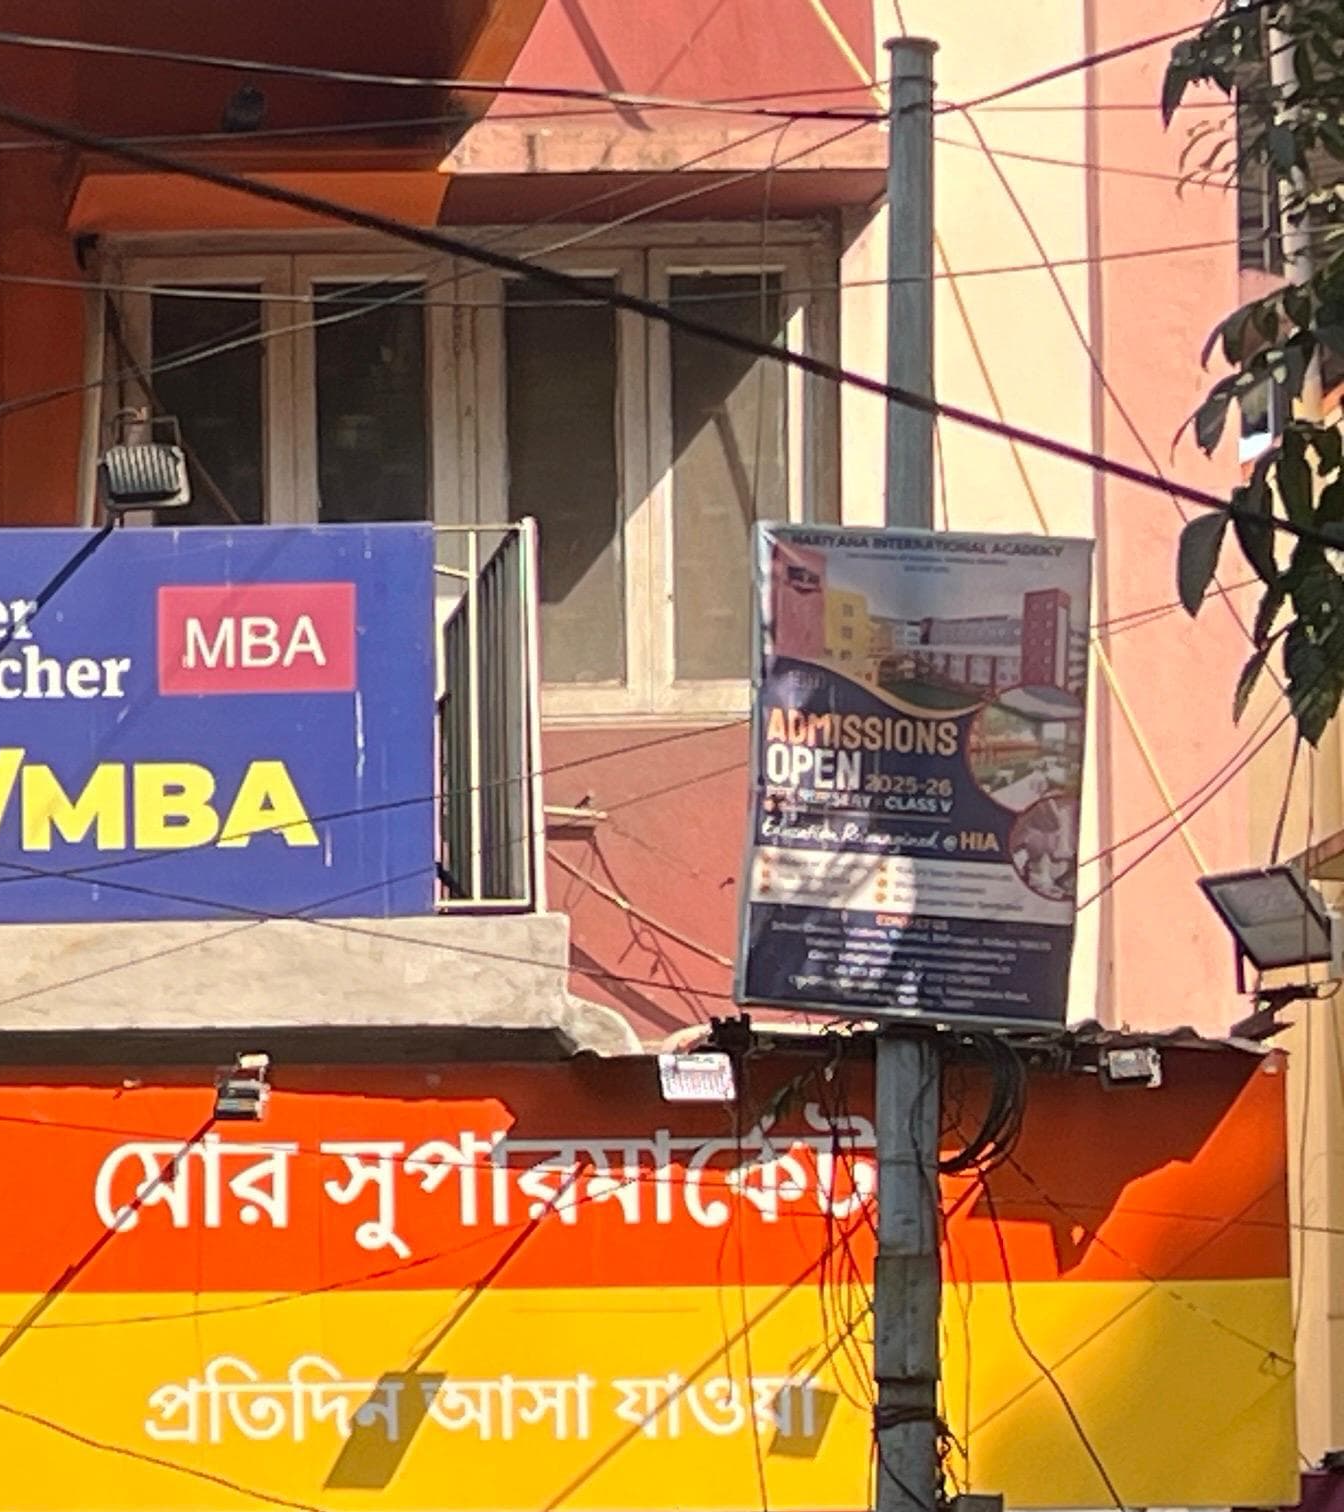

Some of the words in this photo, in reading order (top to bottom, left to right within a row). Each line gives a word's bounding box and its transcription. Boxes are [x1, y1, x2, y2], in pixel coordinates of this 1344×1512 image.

[184, 614, 326, 668] MBA
[766, 707, 959, 757] ADMISSIONS
[766, 744, 862, 791] OPEN
[864, 774, 953, 797] 2025-26
[93, 1130, 299, 1233] মোর
[144, 1354, 405, 1446] প্রতিদিন
[421, 1369, 595, 1443] আসা
[613, 1369, 820, 1443] যাওয়া
